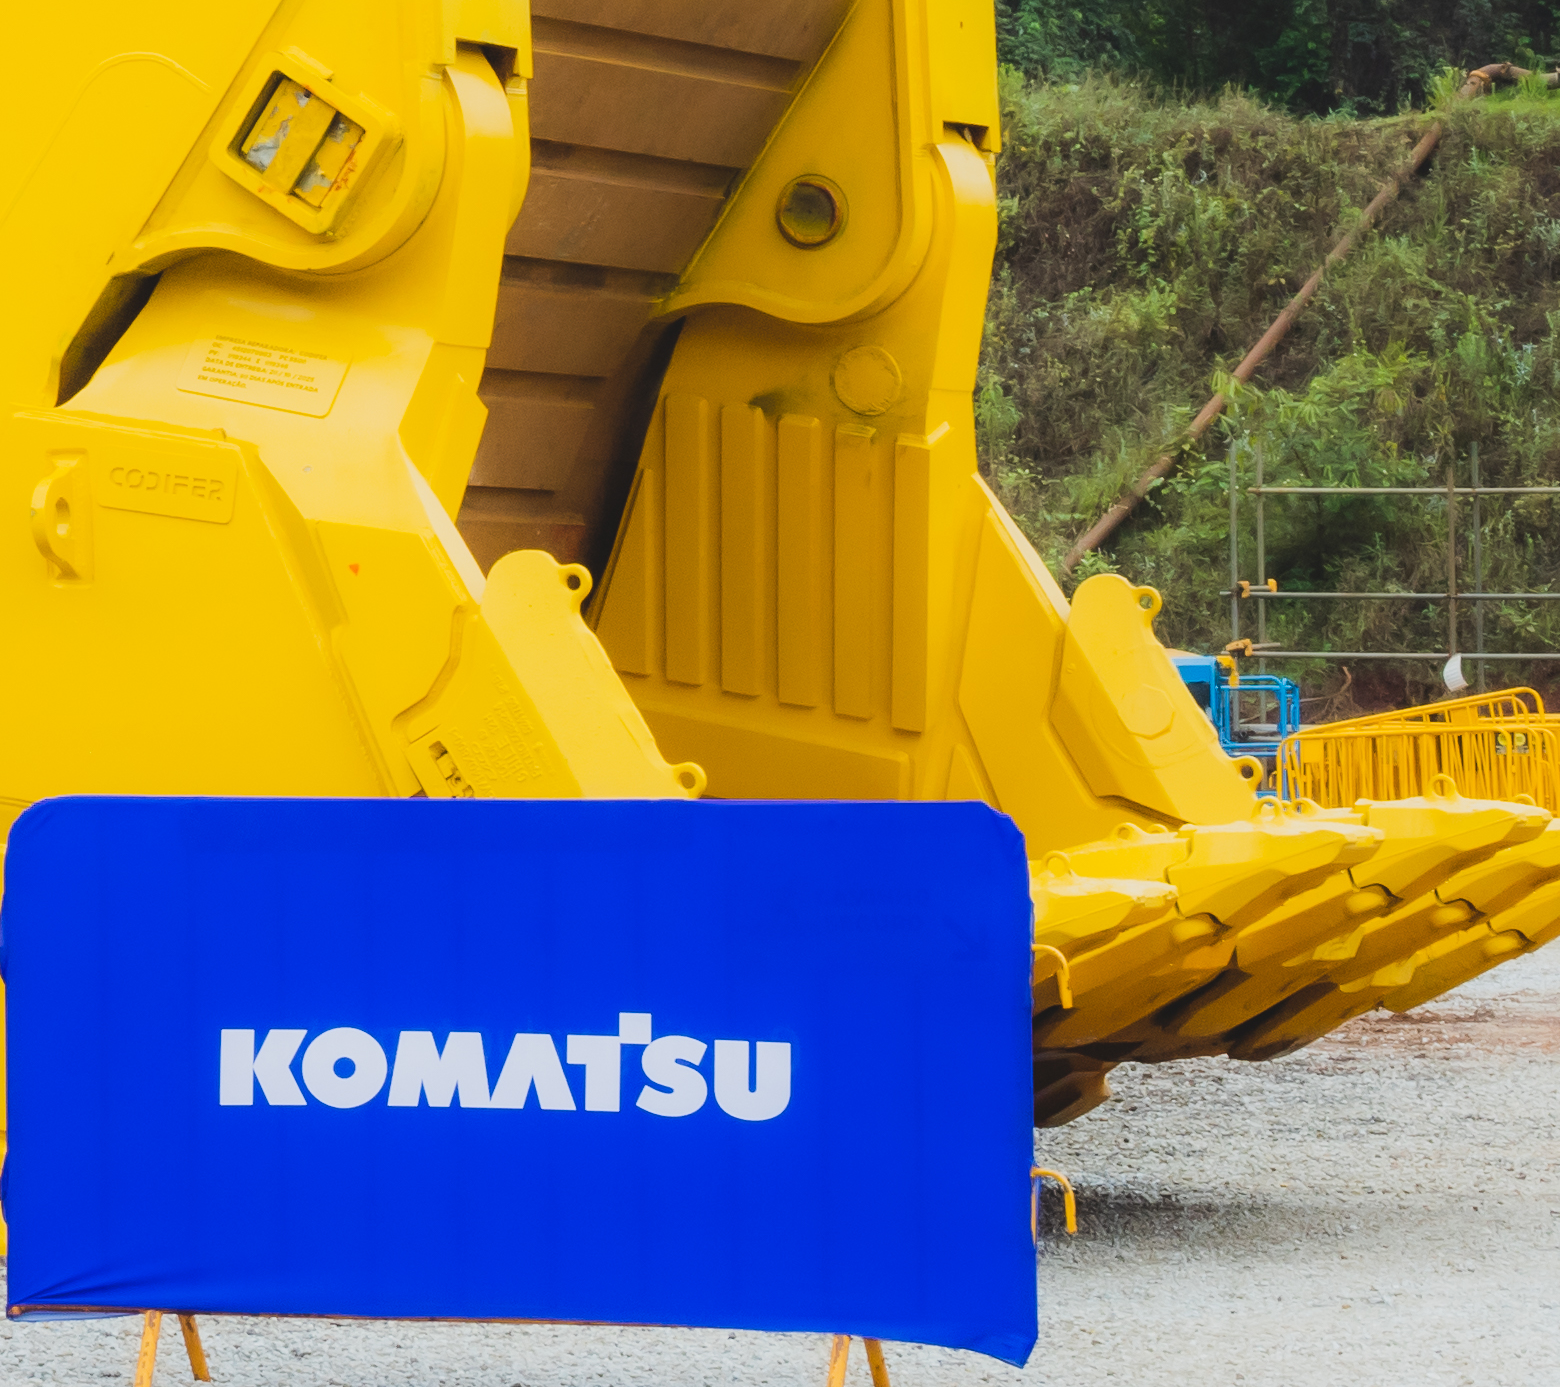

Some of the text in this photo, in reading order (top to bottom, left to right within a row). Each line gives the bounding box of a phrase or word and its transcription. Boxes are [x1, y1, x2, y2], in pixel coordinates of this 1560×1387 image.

[204, 356, 224, 364] DATA
[285, 382, 319, 392] ENTRADA
[109, 467, 224, 501] CODIFER
[219, 1012, 792, 1122] KOMATSU
